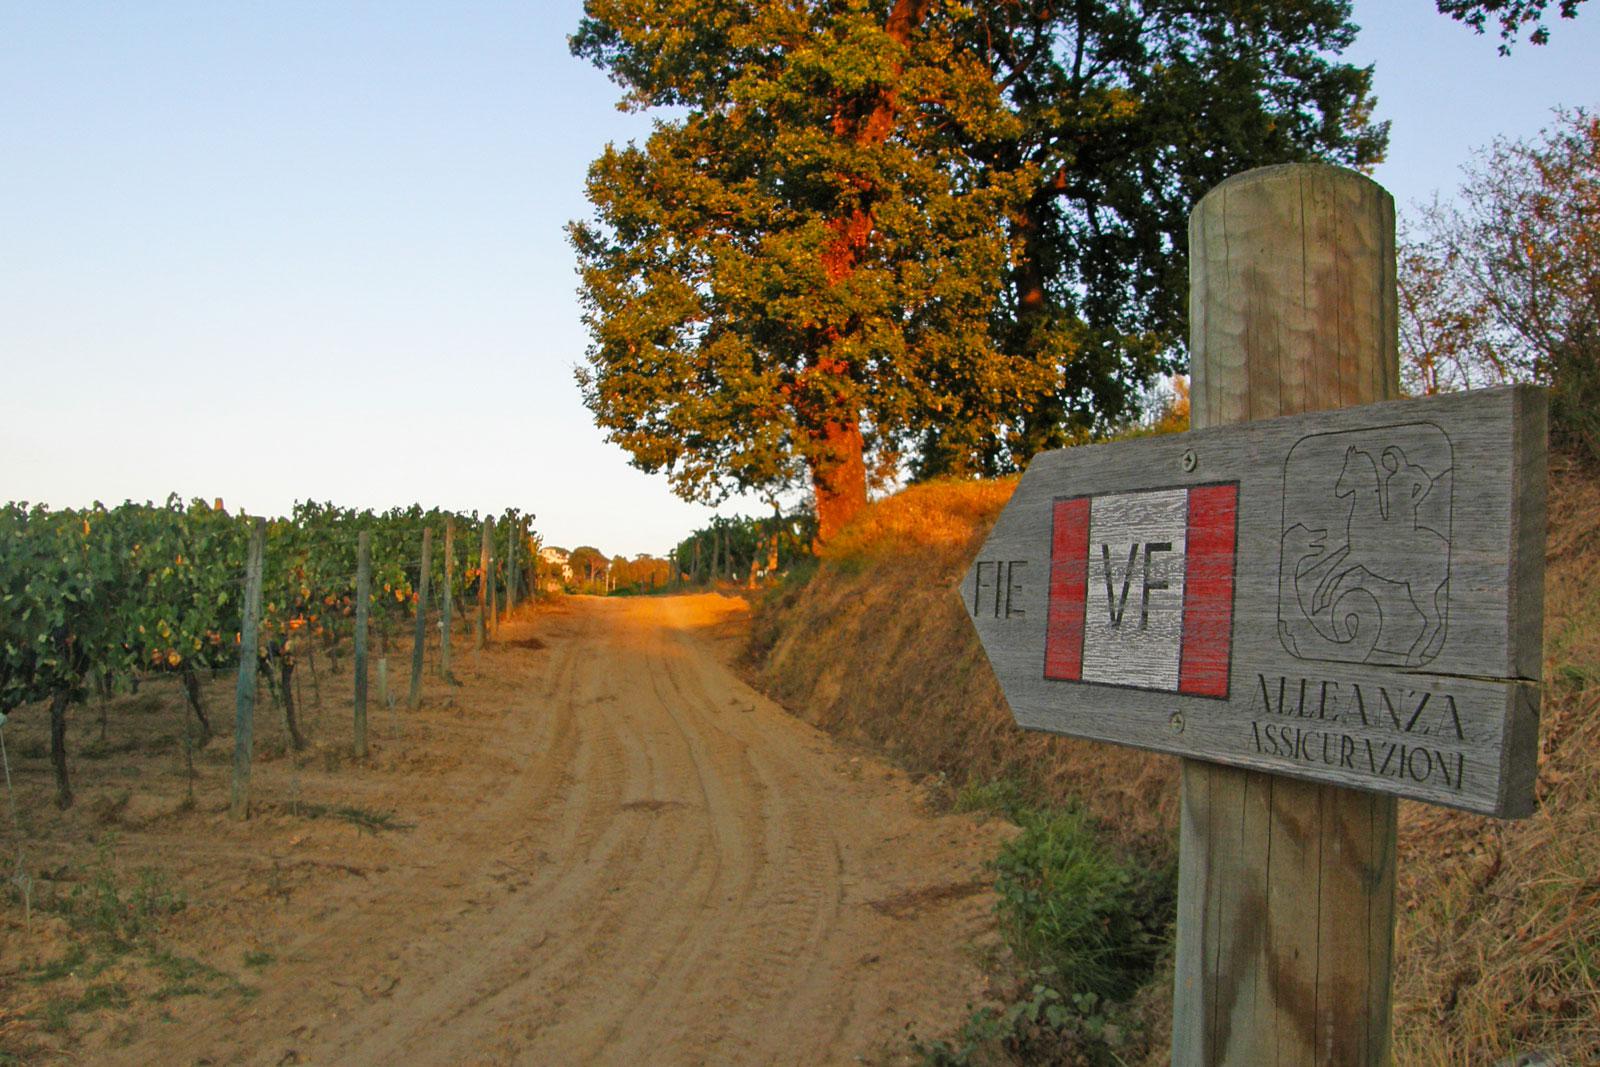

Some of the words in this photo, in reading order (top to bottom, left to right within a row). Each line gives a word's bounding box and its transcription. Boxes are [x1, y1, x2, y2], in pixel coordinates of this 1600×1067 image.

[973, 560, 1029, 619] FIE
[1101, 542, 1173, 631] VF
[1251, 673, 1465, 741] ALLEANZA
[1250, 720, 1465, 791] ASSICURAZIONI
